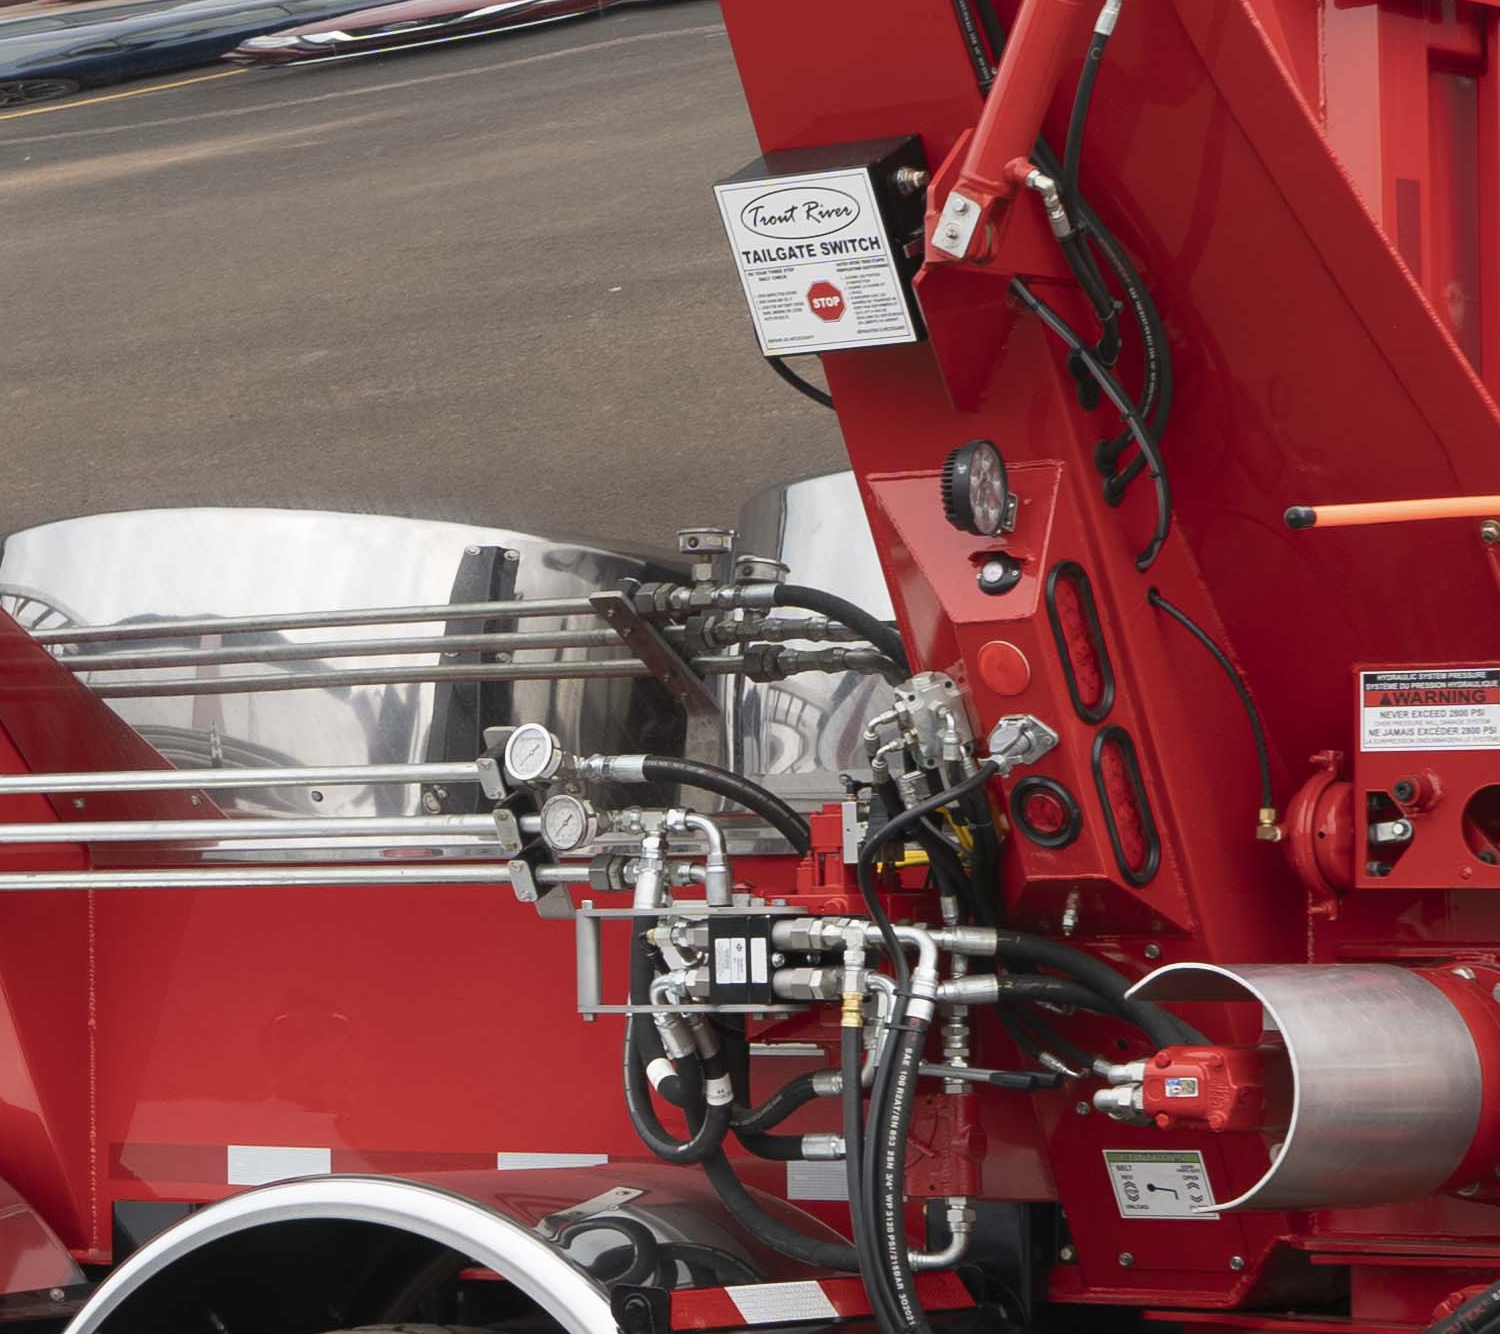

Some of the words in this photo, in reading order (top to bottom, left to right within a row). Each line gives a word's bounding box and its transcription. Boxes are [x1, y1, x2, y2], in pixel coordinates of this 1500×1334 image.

[748, 205, 799, 228] Trout
[803, 200, 852, 223] River
[742, 244, 816, 264] TAILGATE
[819, 236, 882, 257] SWITCH
[812, 297, 841, 309] STOP
[1418, 672, 1447, 680] SYSTEM
[1448, 671, 1486, 679] PRESSURE
[1393, 689, 1486, 705] WARNING
[1380, 710, 1409, 718] NEVER
[1412, 709, 1446, 718] EXCEED
[1471, 708, 1485, 716] PSI
[1383, 728, 1415, 736] JAMAIS
[1483, 726, 1497, 734] PSI
[903, 1047, 913, 1067] SAE
[897, 1071, 908, 1086] 100
[885, 1194, 894, 1209] WP
